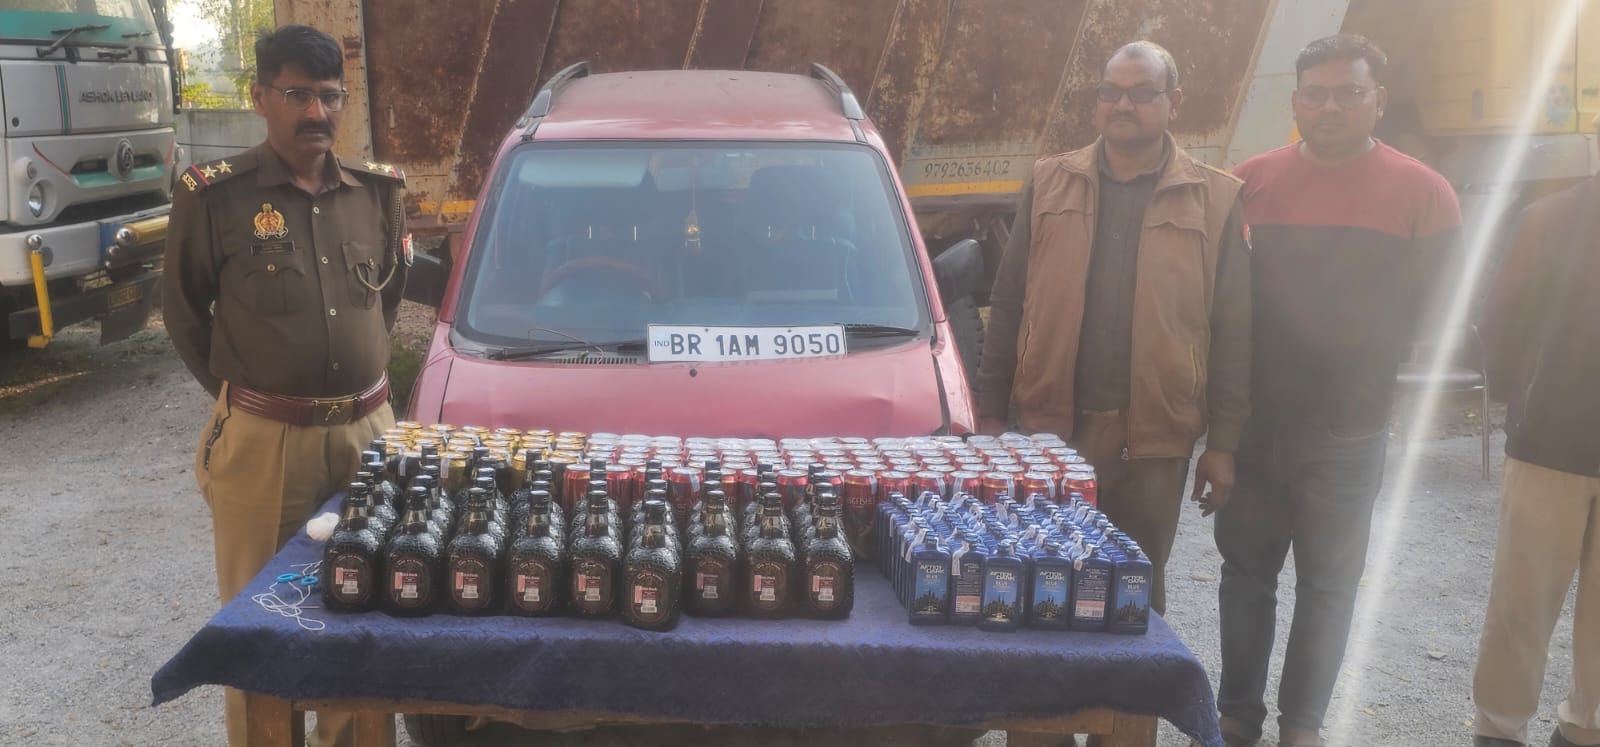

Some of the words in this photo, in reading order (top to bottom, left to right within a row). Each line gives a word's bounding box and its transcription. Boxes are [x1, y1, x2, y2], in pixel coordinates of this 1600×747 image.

[671, 333, 702, 355] BR
[715, 334, 760, 356] 1AM
[774, 333, 840, 355] 9050
